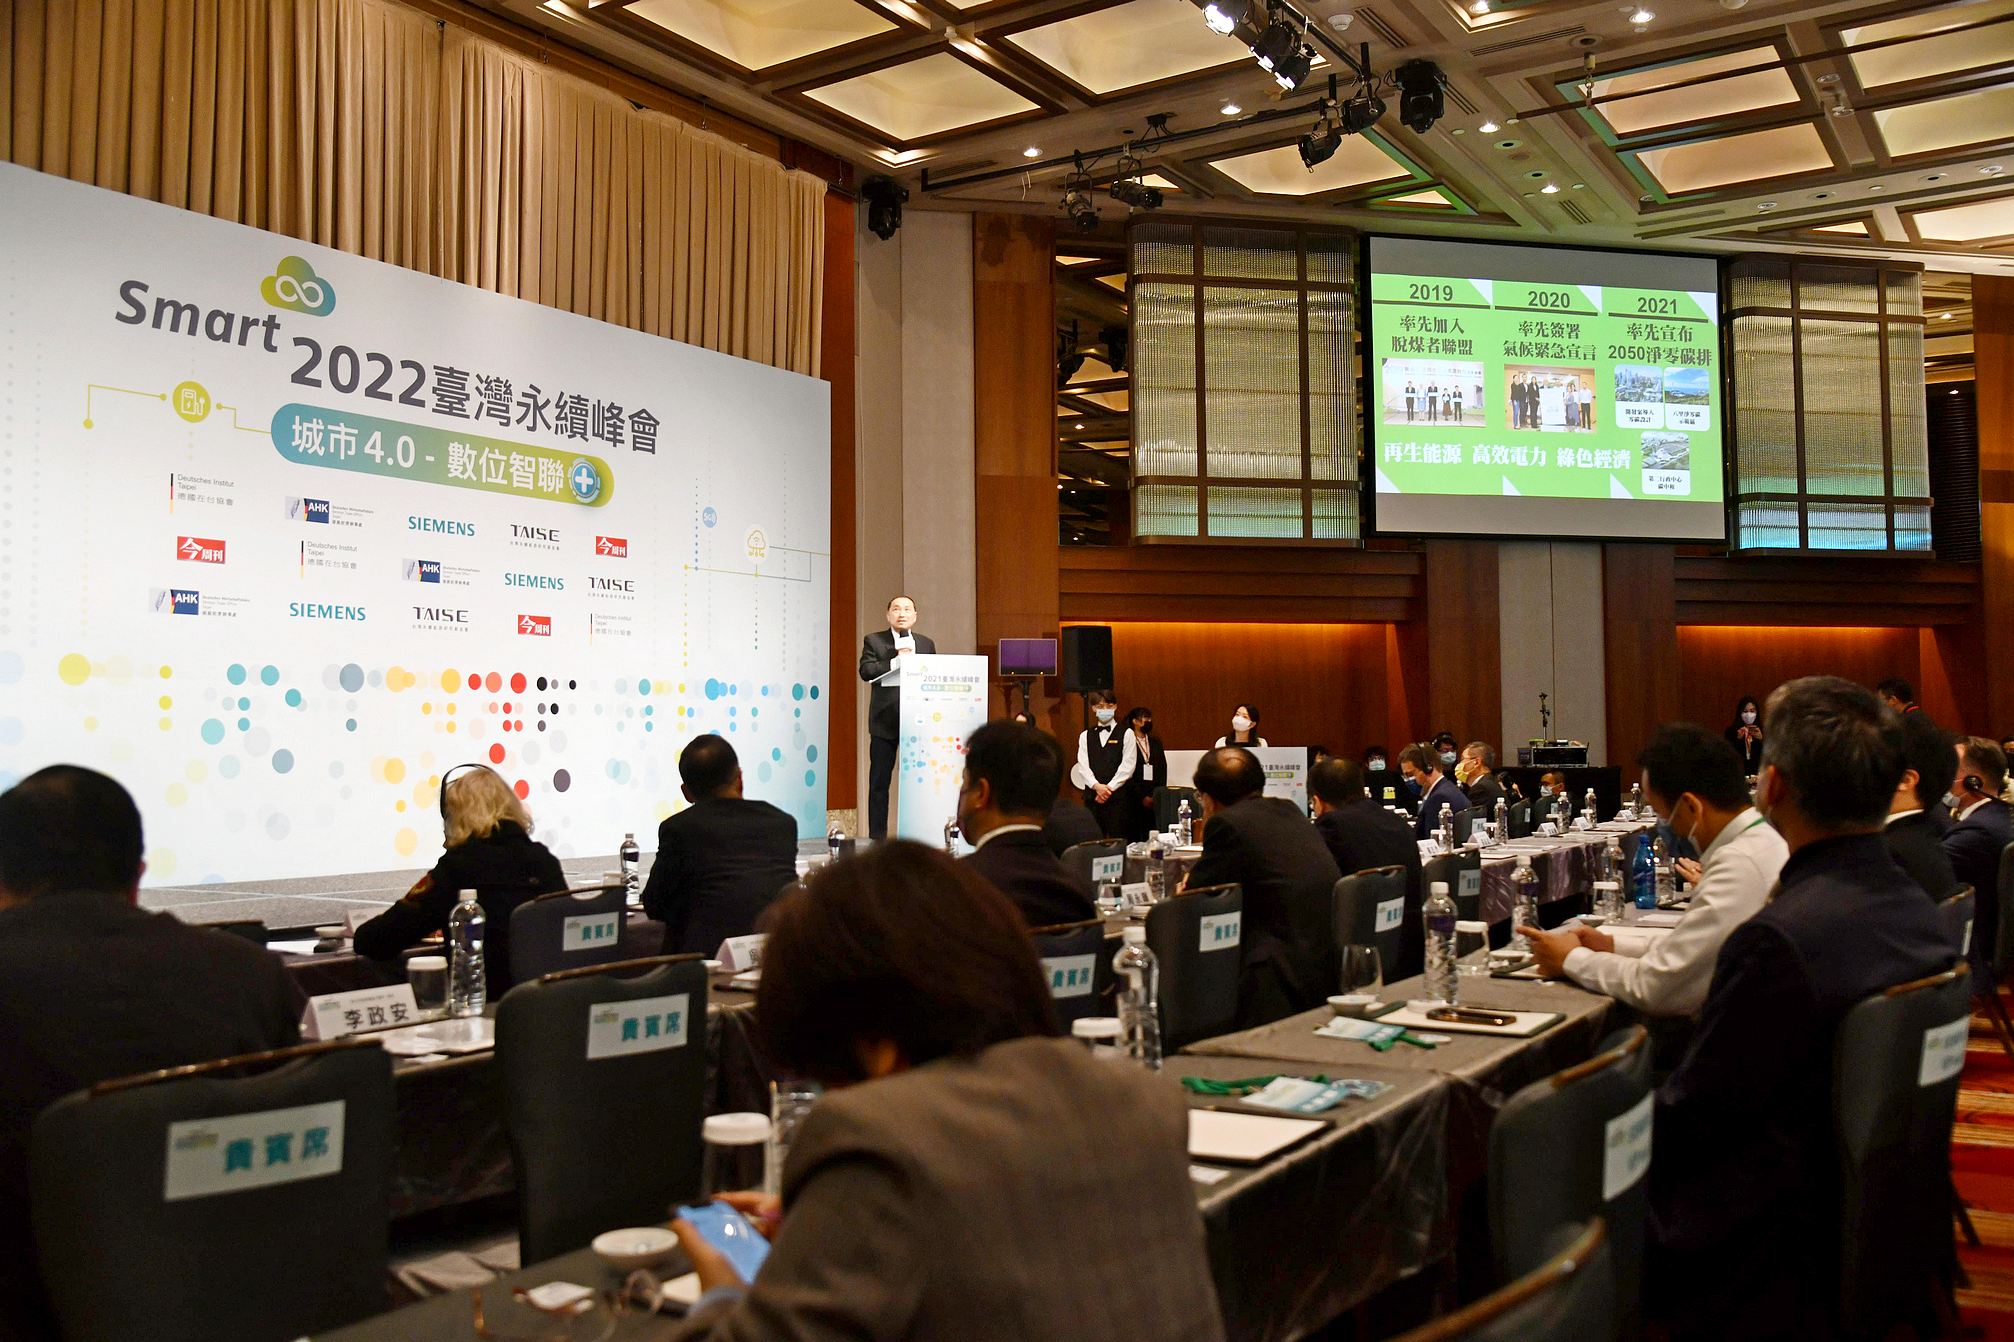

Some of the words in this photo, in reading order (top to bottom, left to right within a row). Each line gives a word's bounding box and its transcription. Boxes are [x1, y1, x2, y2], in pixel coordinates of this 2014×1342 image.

[1409, 283, 1453, 301] 2019
[1528, 291, 1570, 308] 2020
[1637, 297, 1677, 314] 2021
[115, 279, 281, 353] Smart
[1400, 315, 1465, 334] 率先加入
[1518, 320, 1581, 339] 率先簽署
[1627, 322, 1693, 342] 率先宣布
[1391, 336, 1473, 356] 脫煤者聯盟
[1503, 340, 1596, 361] 氣候緊急宣言
[1608, 345, 1712, 366] 2050淨零碳排
[290, 336, 660, 454] 2022臺灣永續峰會
[1383, 442, 1462, 465] 再生能源
[1472, 444, 1547, 467] 高效電力
[1557, 447, 1631, 470] 綠色經濟
[447, 441, 564, 495] 數位智聯
[308, 502, 329, 514] AHK
[408, 516, 475, 536] SIEMENS
[510, 524, 560, 542] TAISE
[422, 564, 440, 573] AHK
[504, 573, 564, 590] SIEMENS
[588, 577, 634, 592] TAISE
[175, 593, 198, 604] AHK
[289, 602, 366, 621] SIEMENS
[413, 606, 469, 623] TAISE
[344, 1002, 409, 1029] 李政安
